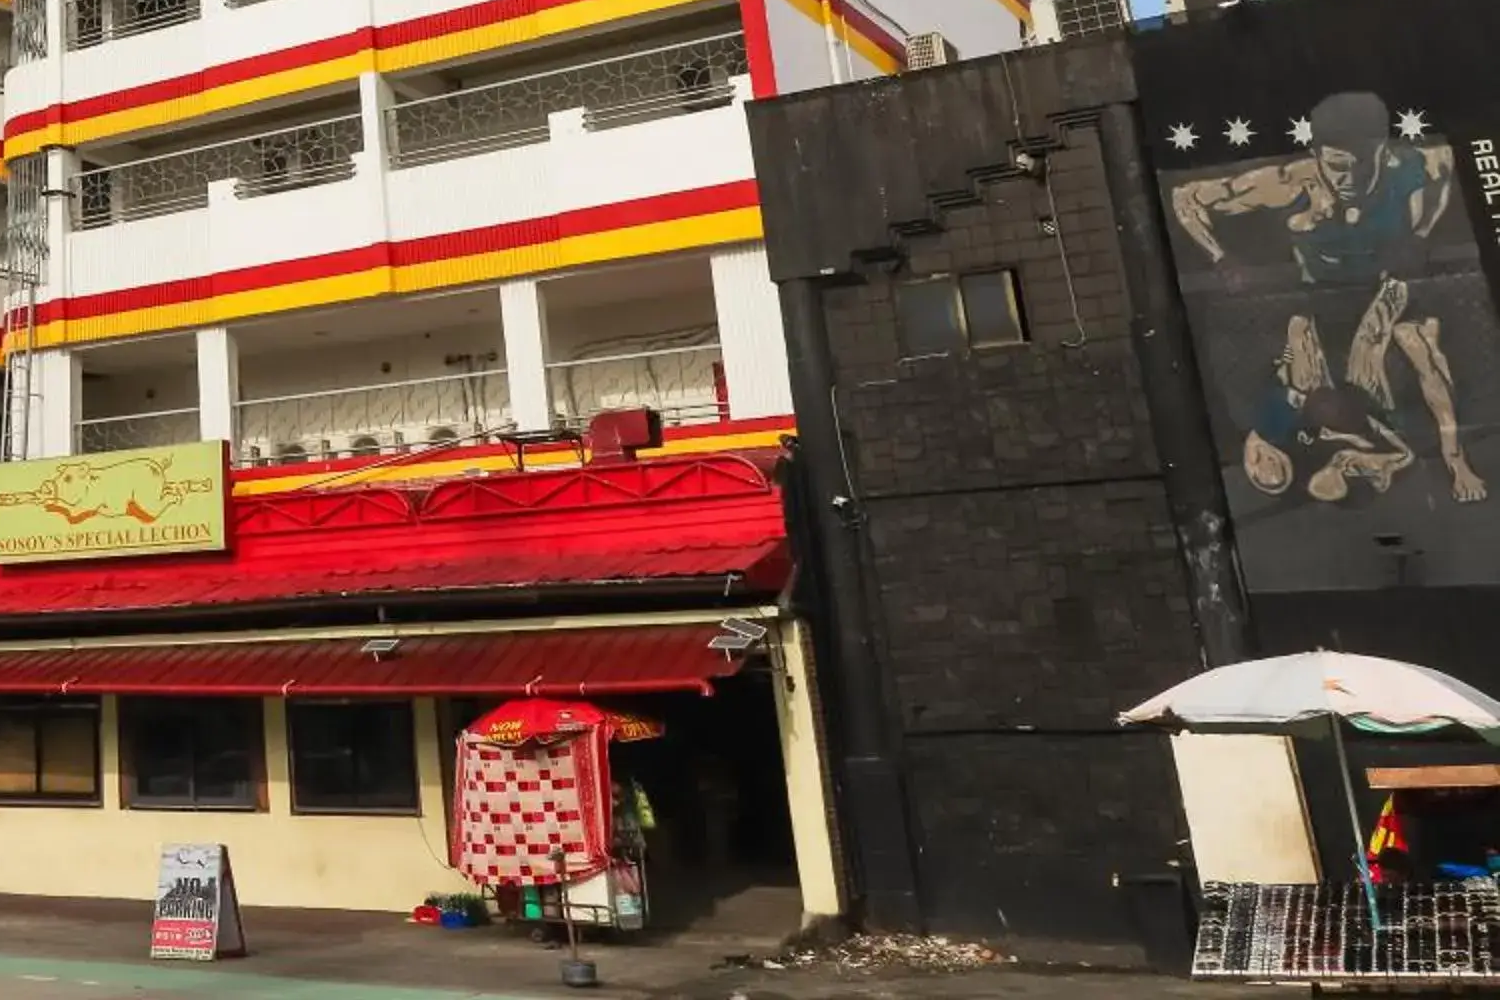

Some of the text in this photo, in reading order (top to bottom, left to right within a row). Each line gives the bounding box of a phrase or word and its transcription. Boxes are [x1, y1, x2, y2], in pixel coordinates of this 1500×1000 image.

[1471, 139, 1500, 206] REAL
[67, 528, 135, 548] SPECIAL
[139, 522, 212, 542] LECHON
[175, 876, 202, 898] NO
